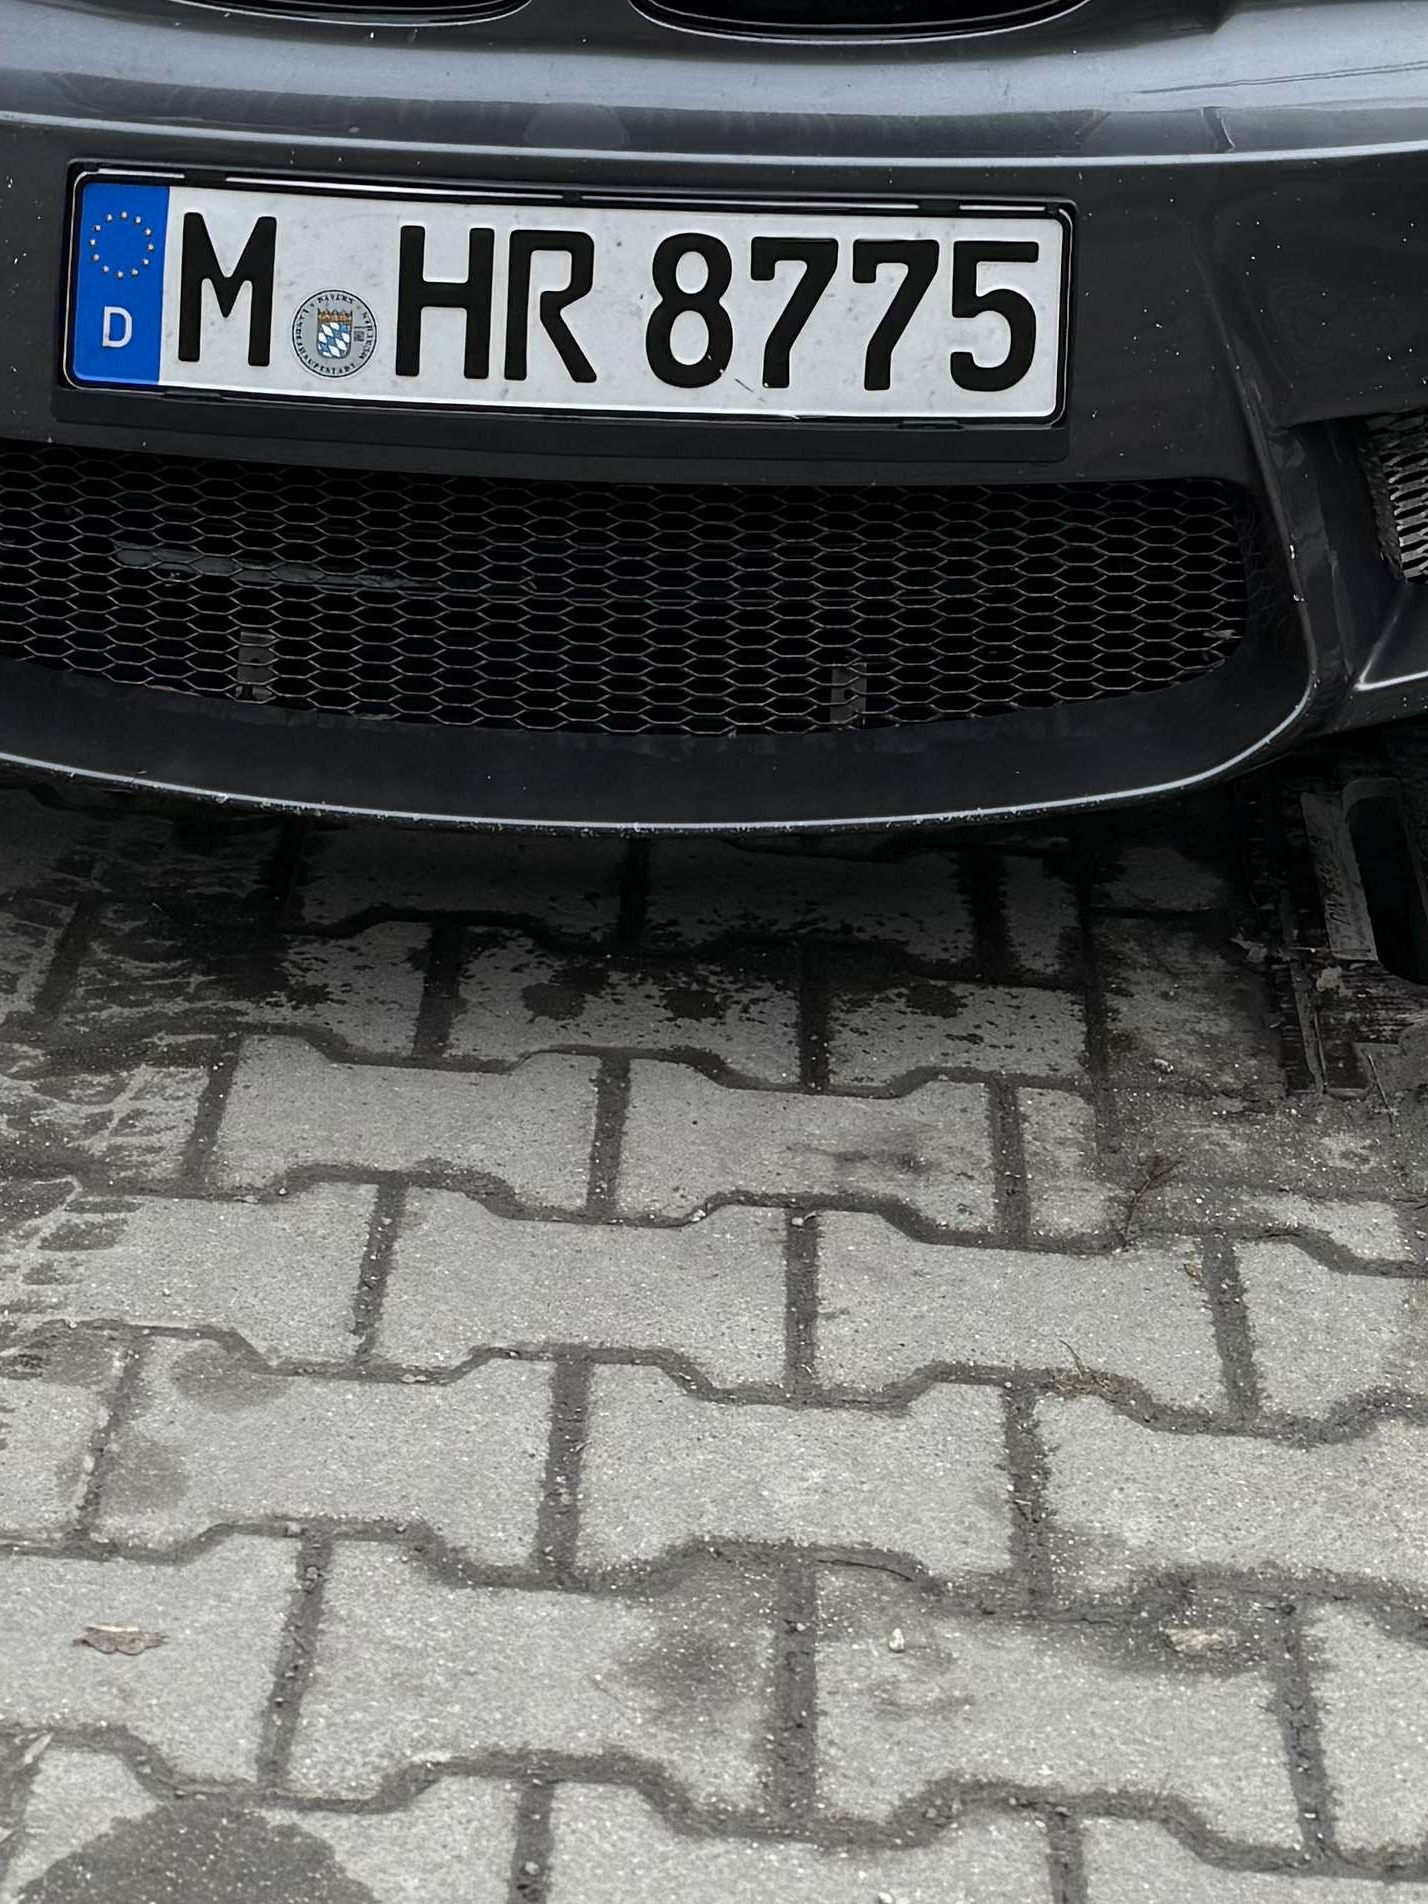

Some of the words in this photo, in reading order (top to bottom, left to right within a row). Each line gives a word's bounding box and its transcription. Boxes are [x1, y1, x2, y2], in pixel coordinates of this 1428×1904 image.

[101, 305, 133, 348] D
[177, 212, 277, 367] M
[395, 225, 598, 384] HR
[645, 232, 1041, 393] 8775
